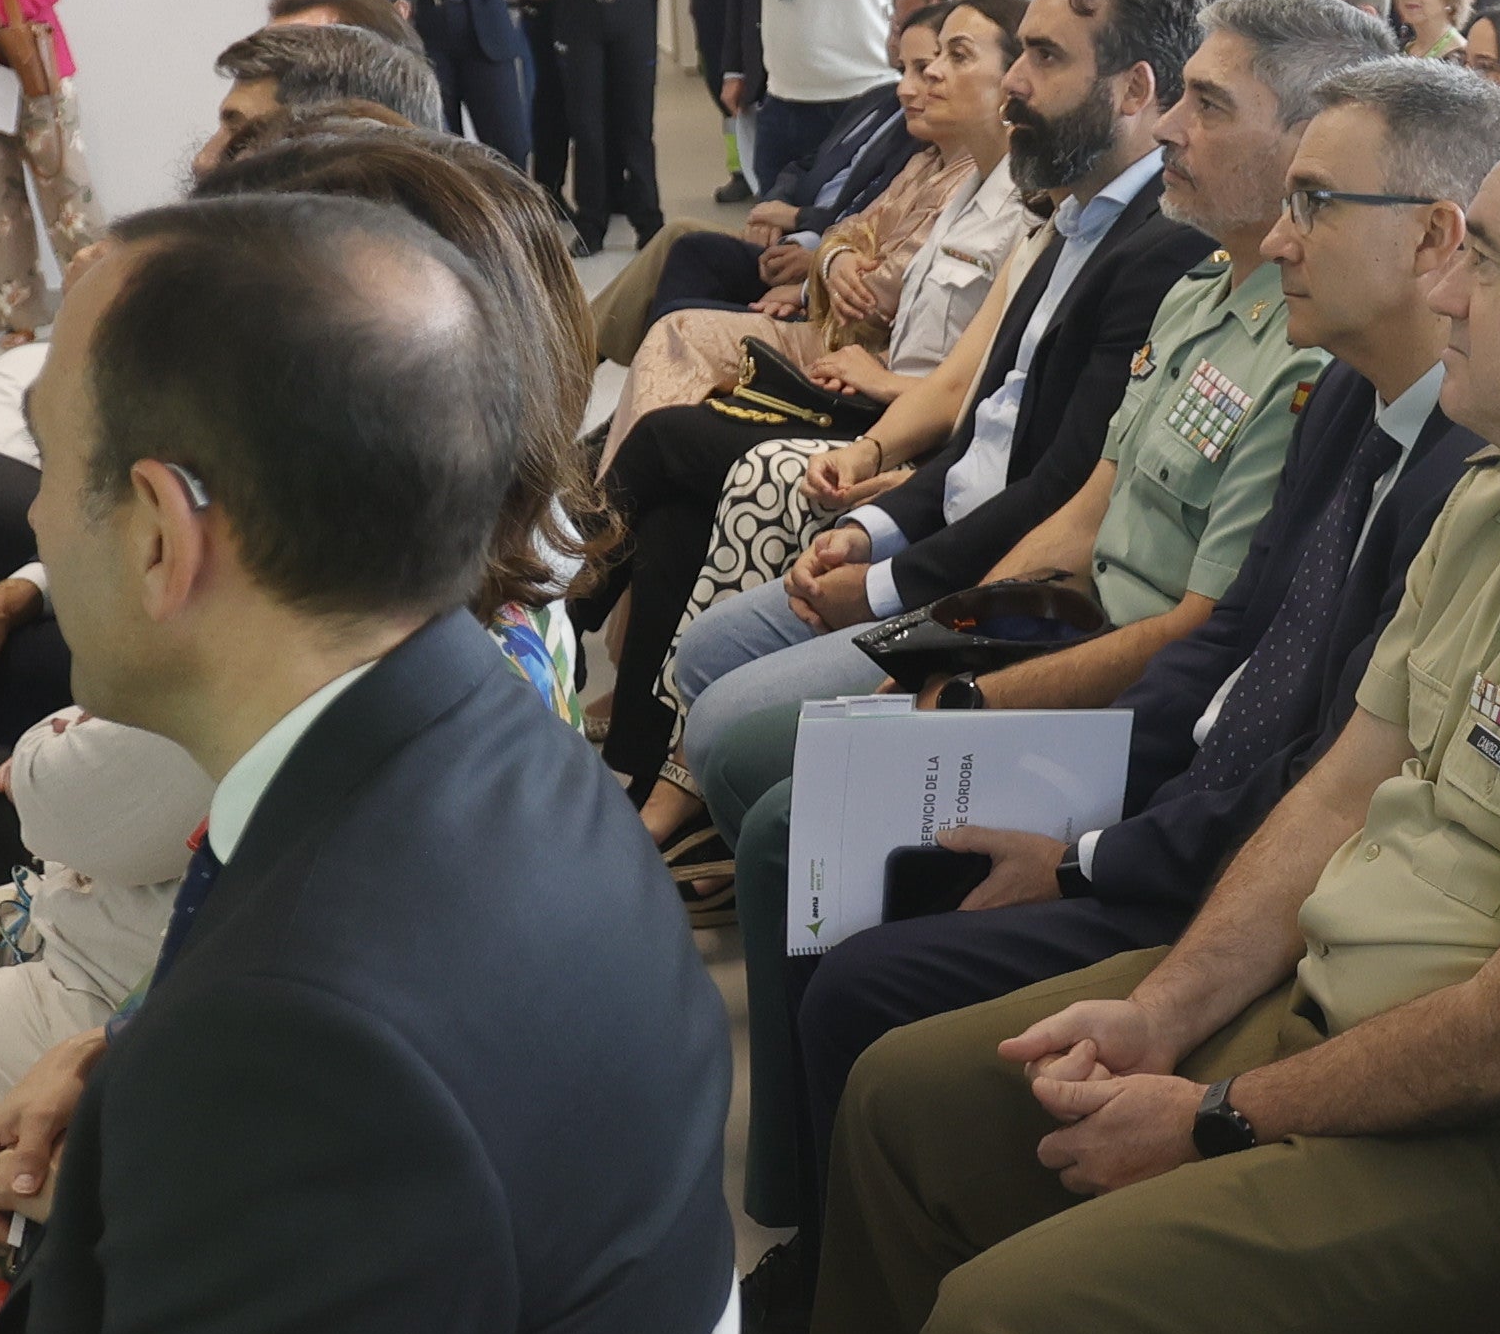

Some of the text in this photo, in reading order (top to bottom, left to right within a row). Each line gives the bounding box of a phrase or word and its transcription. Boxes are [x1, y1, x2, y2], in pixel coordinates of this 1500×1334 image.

[921, 755, 940, 848] SERVICIO DE LA
[955, 753, 974, 813] CÓRDOBA
